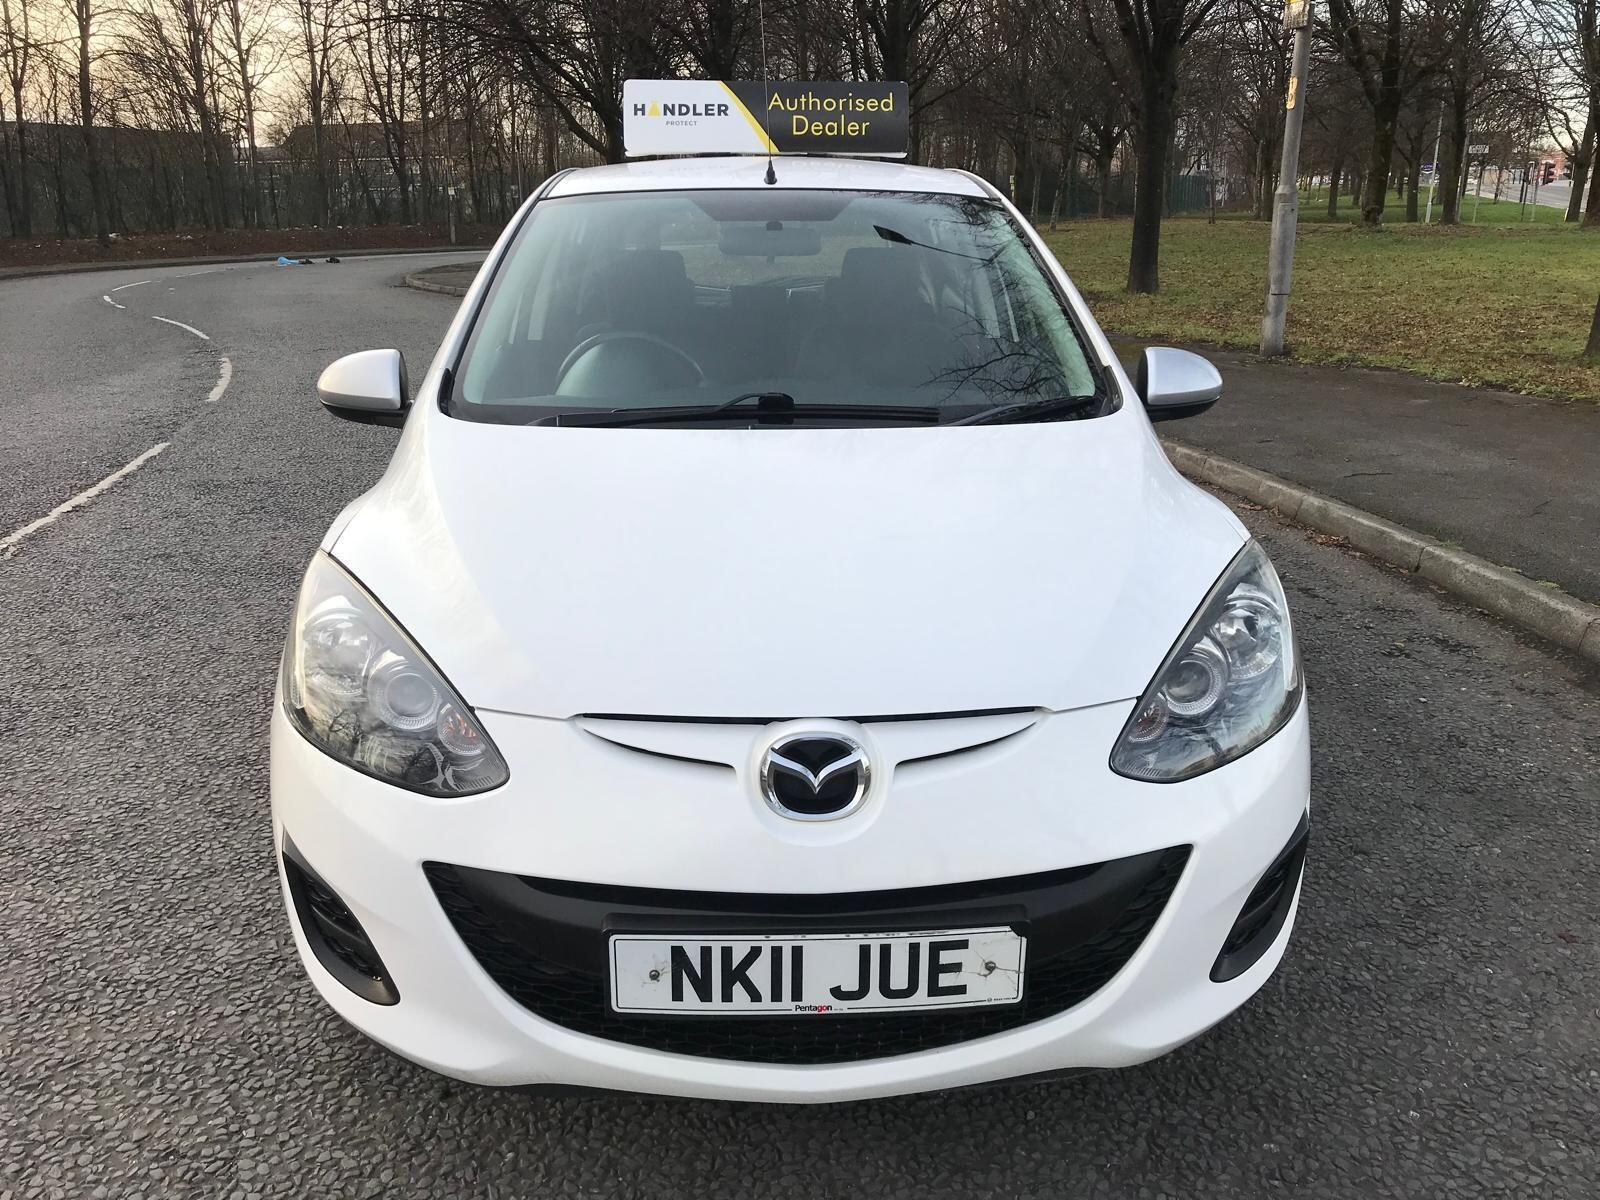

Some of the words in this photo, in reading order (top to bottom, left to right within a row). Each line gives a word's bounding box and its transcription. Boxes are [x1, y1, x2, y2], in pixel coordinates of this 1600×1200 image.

[633, 101, 730, 117] HANDLER
[768, 92, 894, 111] Authorised
[792, 115, 870, 136] Dealer
[670, 945, 804, 1003] NK11
[829, 939, 970, 1001] JUE
[795, 1004, 833, 1013] Pentagon
